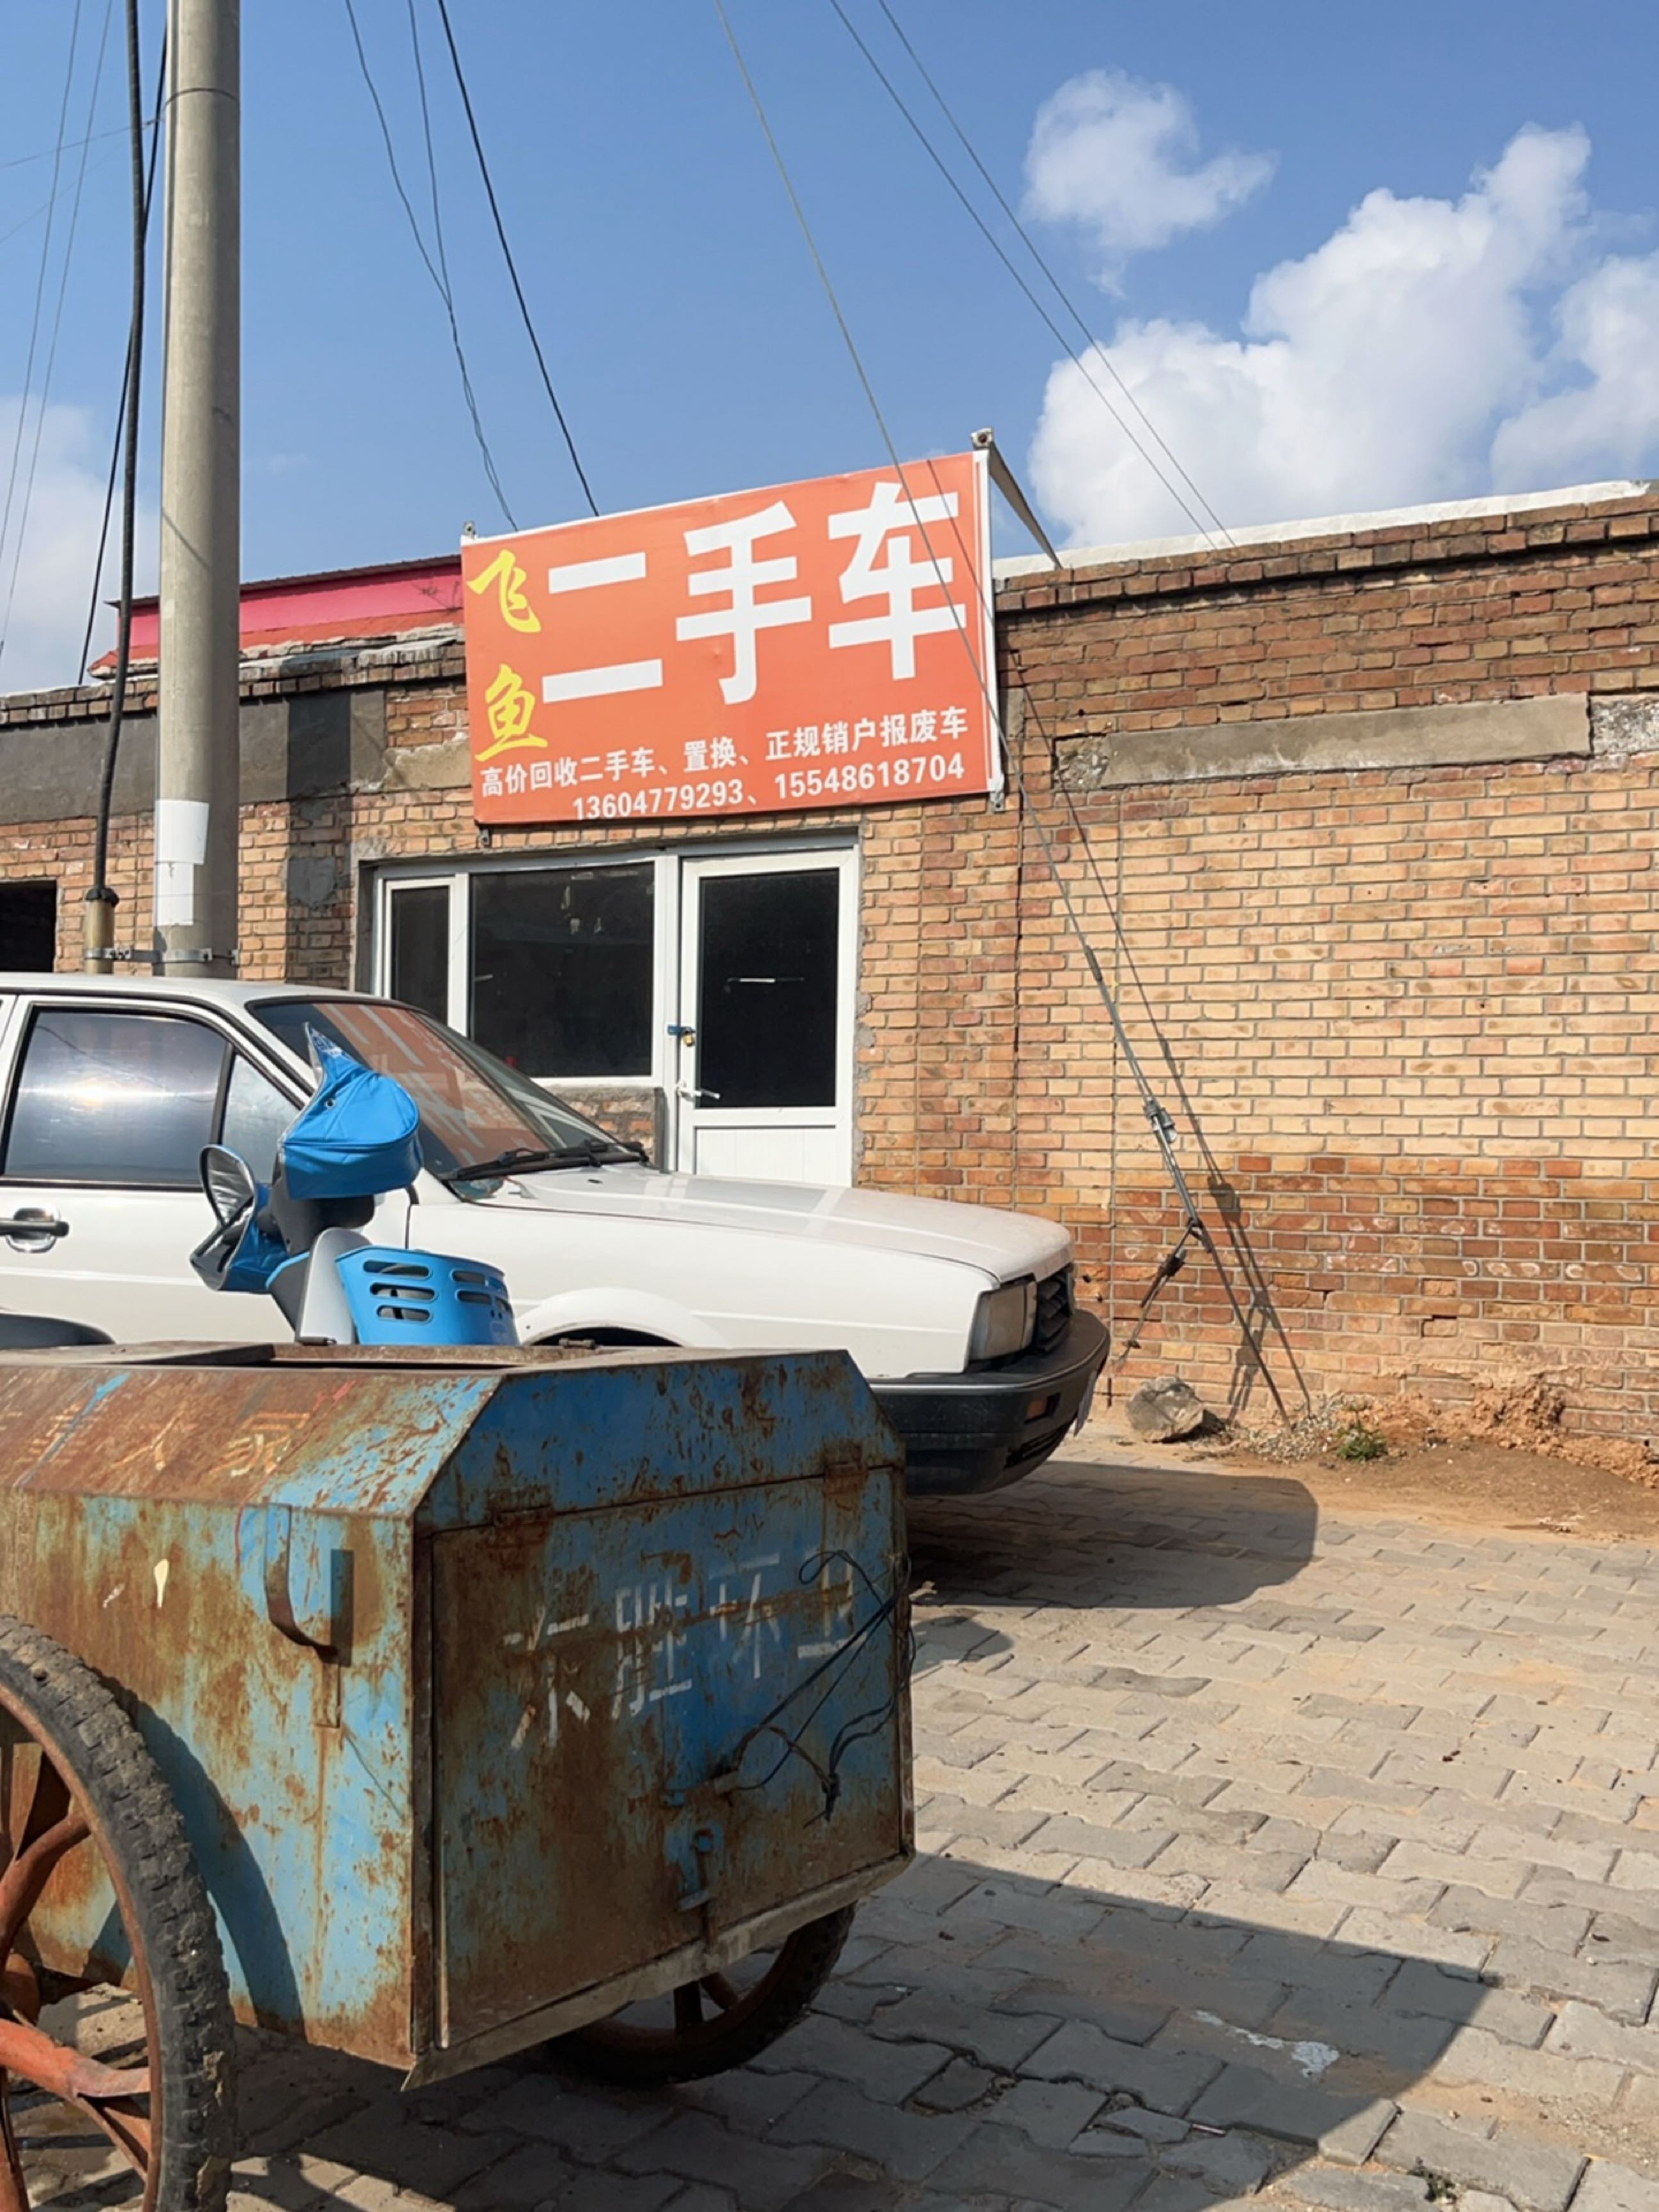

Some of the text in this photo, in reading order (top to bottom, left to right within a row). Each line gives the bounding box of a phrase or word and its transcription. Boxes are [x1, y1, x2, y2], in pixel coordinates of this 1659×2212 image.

[467, 549, 548, 762] 飞鱼
[541, 481, 967, 705] 二手车
[479, 705, 968, 798] 高价回收二手车、置换、正规销户报废车
